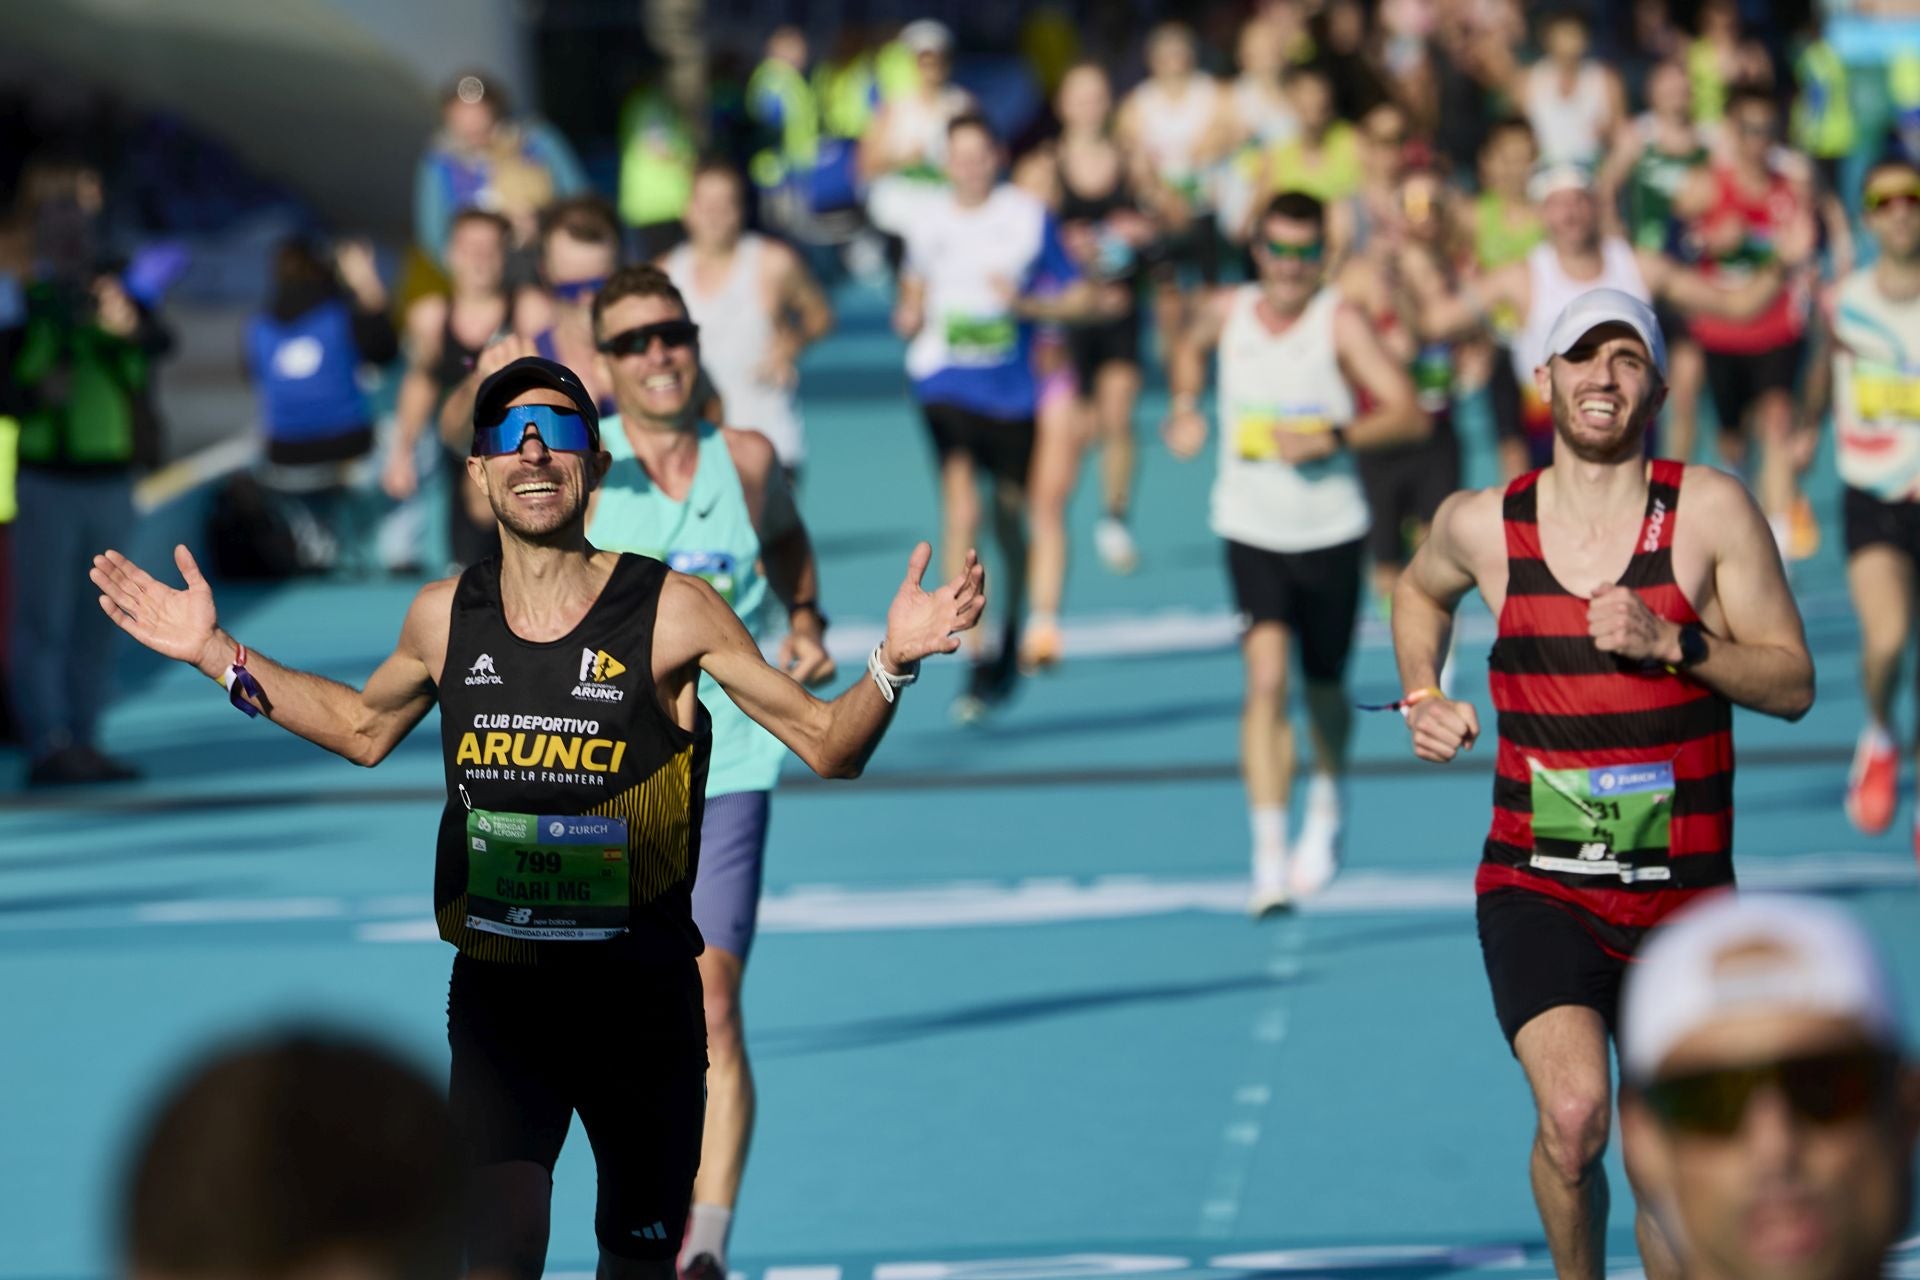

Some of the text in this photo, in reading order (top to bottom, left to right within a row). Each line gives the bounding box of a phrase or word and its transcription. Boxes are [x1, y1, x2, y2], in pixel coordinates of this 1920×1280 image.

[571, 685, 624, 700] ARUNCI
[473, 714, 600, 735] CLUB DEPORTIVO
[456, 732, 627, 773] ARUNCI
[465, 768, 604, 786] MORÓN DE LA FRONTERA
[493, 821, 527, 832] TRINIDAD
[493, 829, 527, 839] ALFONSO
[568, 824, 608, 835] ZURICH
[515, 850, 562, 875] 799
[496, 876, 591, 901] CHARI MG
[511, 928, 541, 937] TRINIDAD
[542, 929, 576, 938] ALFONSO
